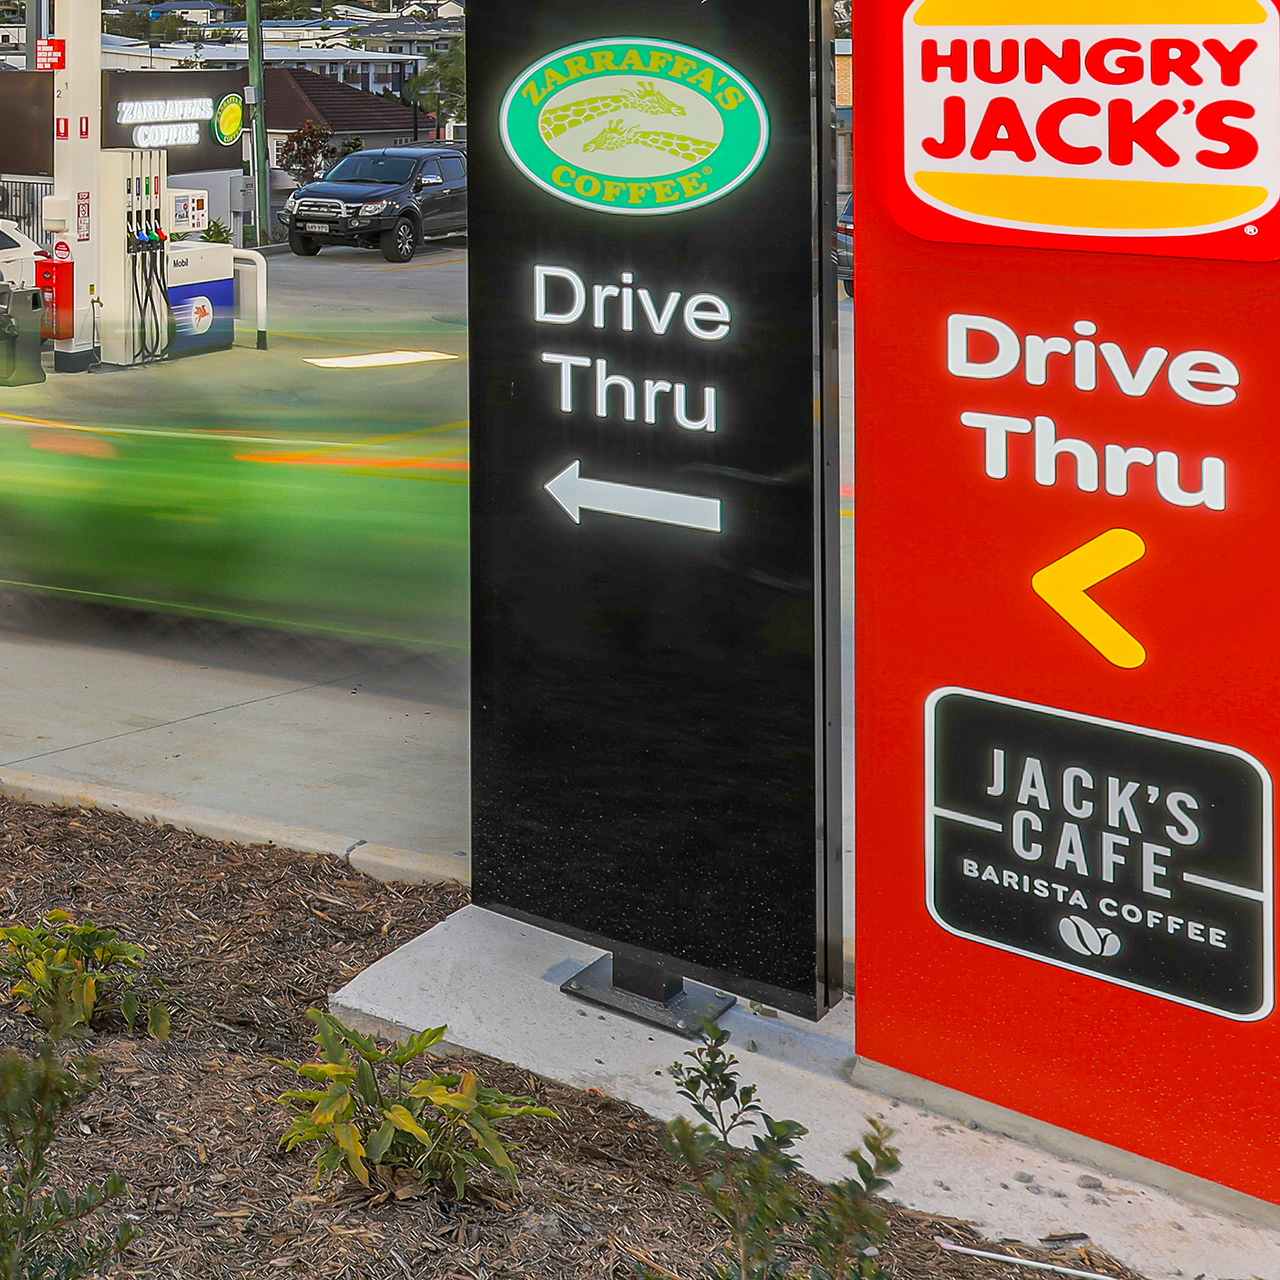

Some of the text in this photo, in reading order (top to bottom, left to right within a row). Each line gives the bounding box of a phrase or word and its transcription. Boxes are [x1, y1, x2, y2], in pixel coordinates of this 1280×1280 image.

[56, 89, 62, 98] 2
[64, 82, 69, 90] 1
[521, 49, 746, 112] ZARRAFFA'S
[921, 38, 1258, 87] HUNGRY
[132, 122, 200, 148] COFFEE
[921, 96, 1259, 170] JACK'S
[551, 165, 708, 204] COFFEE
[173, 258, 189, 268] Mobil
[533, 265, 732, 341] Drive
[540, 351, 718, 434] Thru
[947, 313, 1241, 407] Drive
[960, 411, 1227, 512] Thru
[987, 748, 1201, 846] JACK'S
[1011, 810, 1172, 899] CAFE
[962, 858, 1228, 949] BARISTA COFFEE
